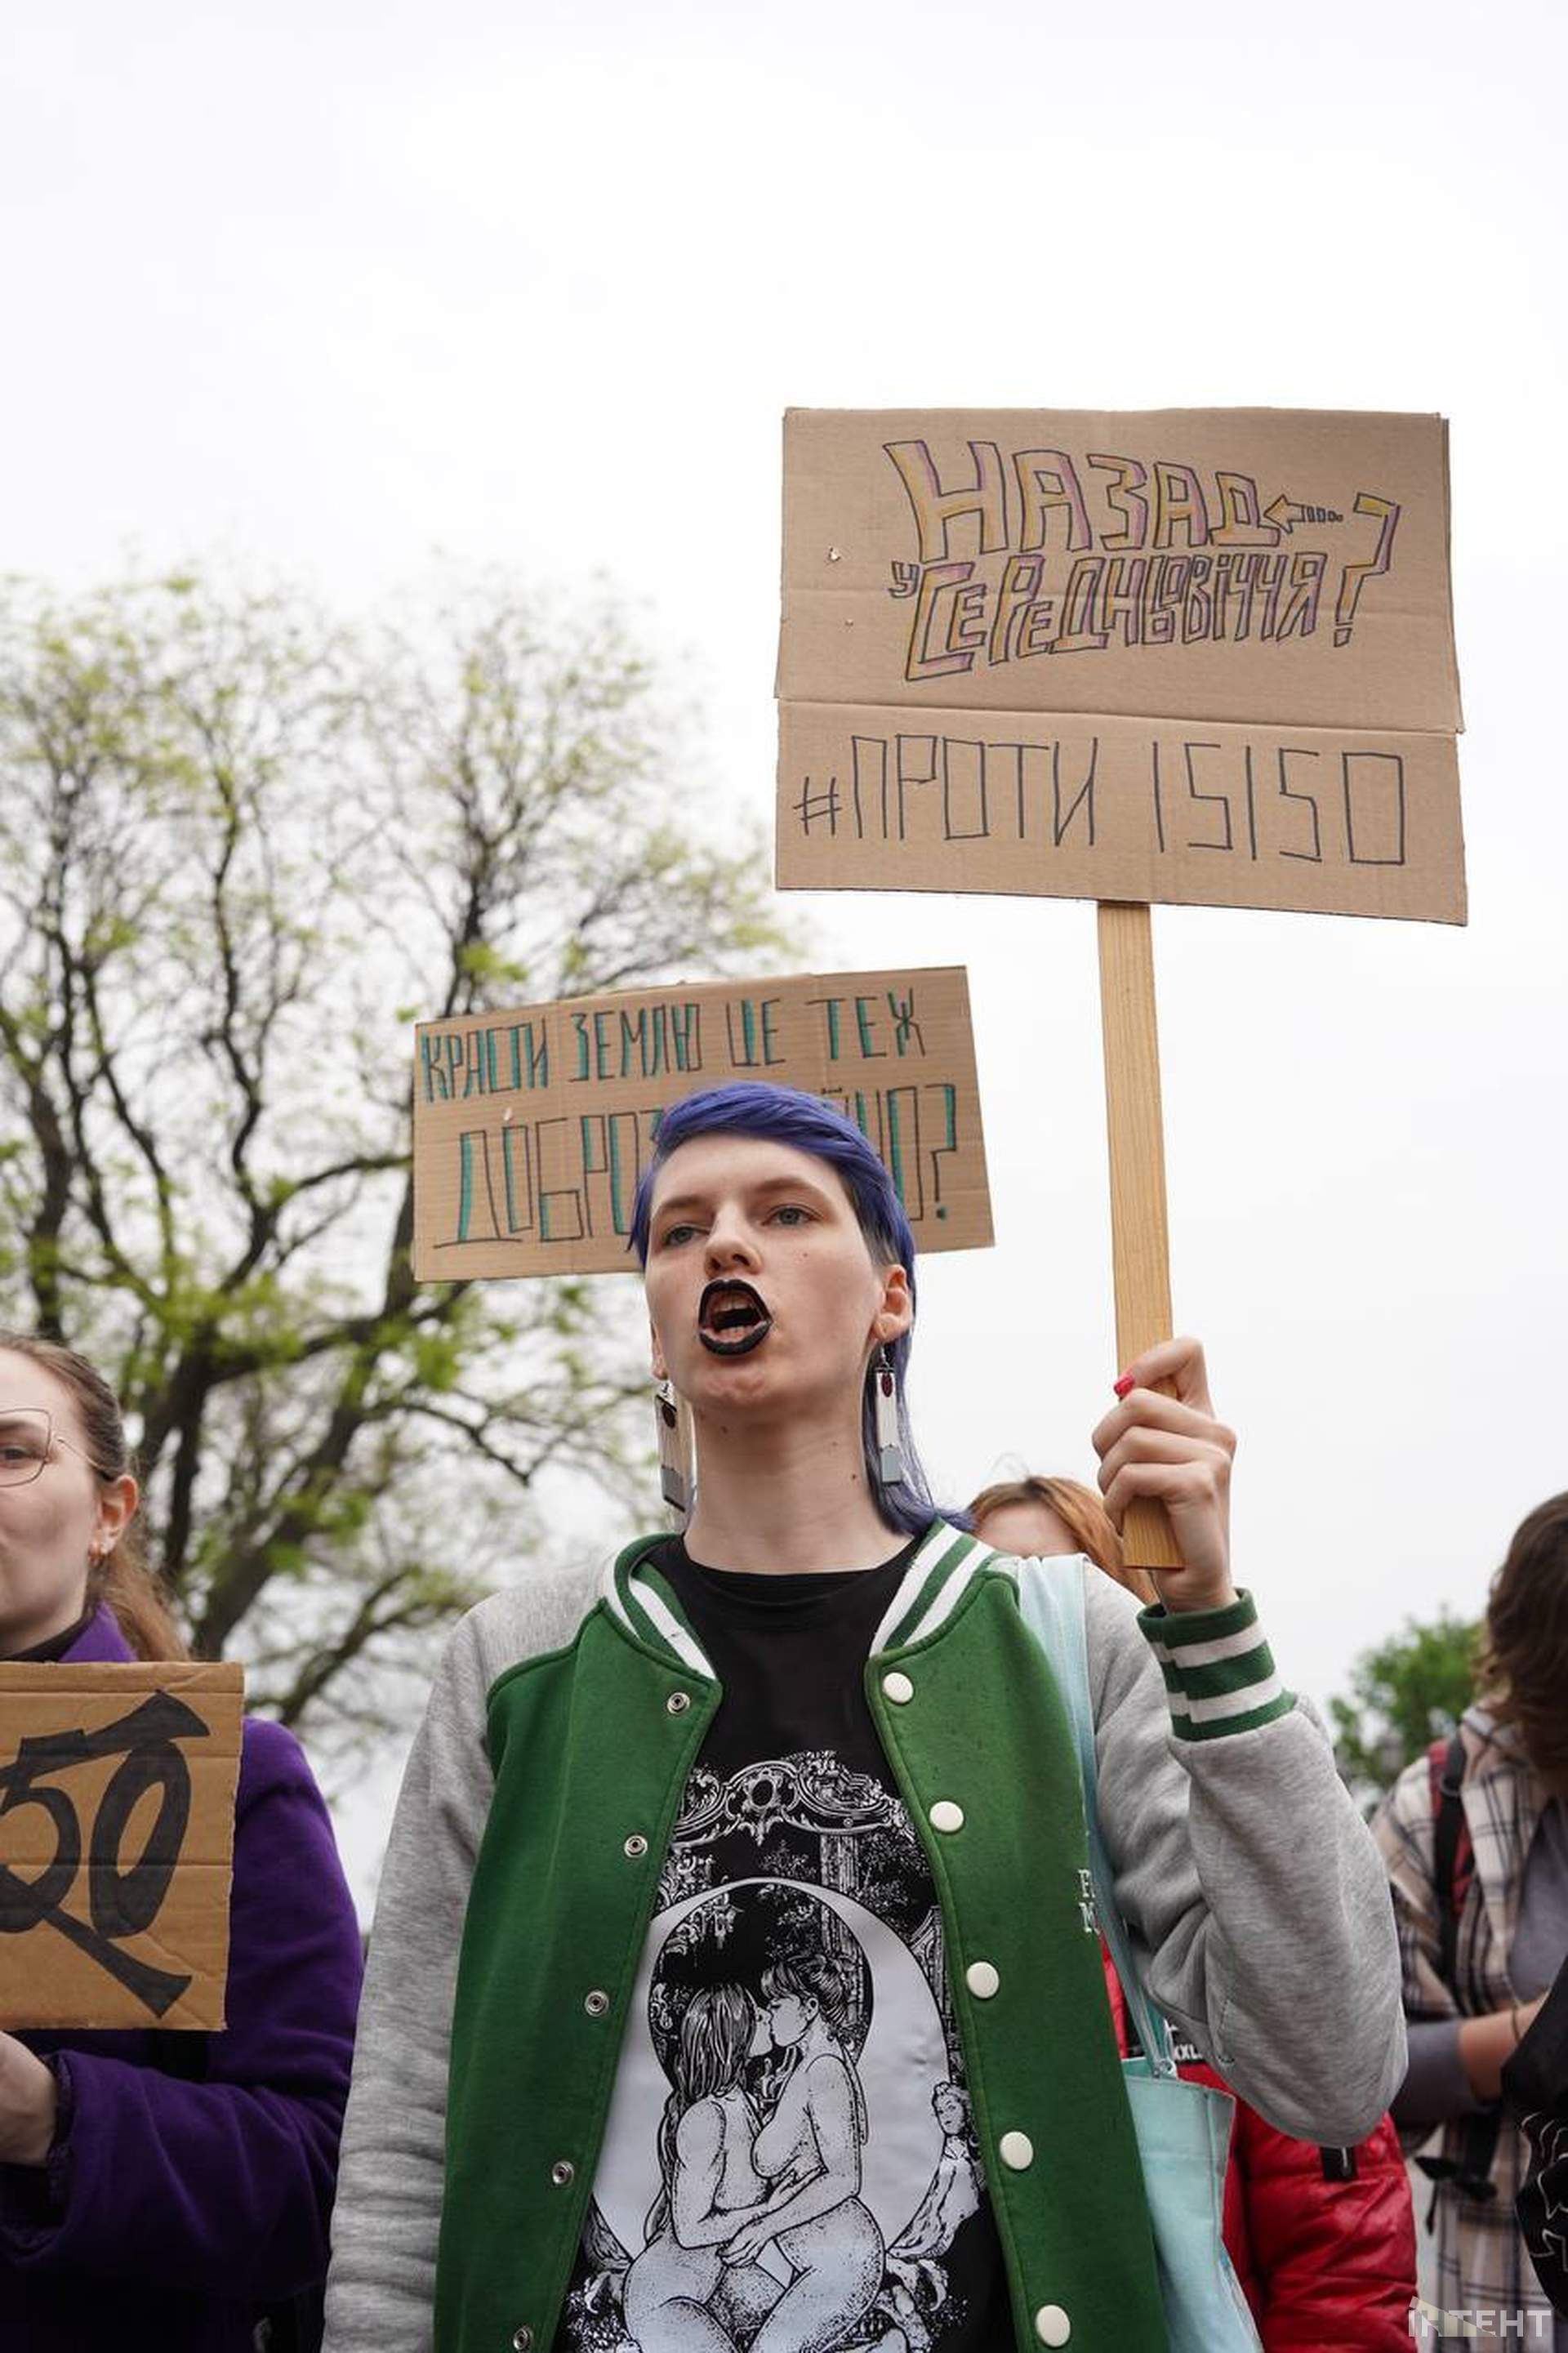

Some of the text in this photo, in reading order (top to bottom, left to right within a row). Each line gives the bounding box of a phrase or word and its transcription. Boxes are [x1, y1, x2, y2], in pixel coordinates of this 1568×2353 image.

[884, 441, 1281, 562] НАЗАД
[794, 733, 1098, 846] #ПРОТИ
[569, 1003, 703, 1082] ЗЕМЛЮ
[726, 998, 786, 1067] ЦЕ
[805, 987, 927, 1062] ТЕЖ
